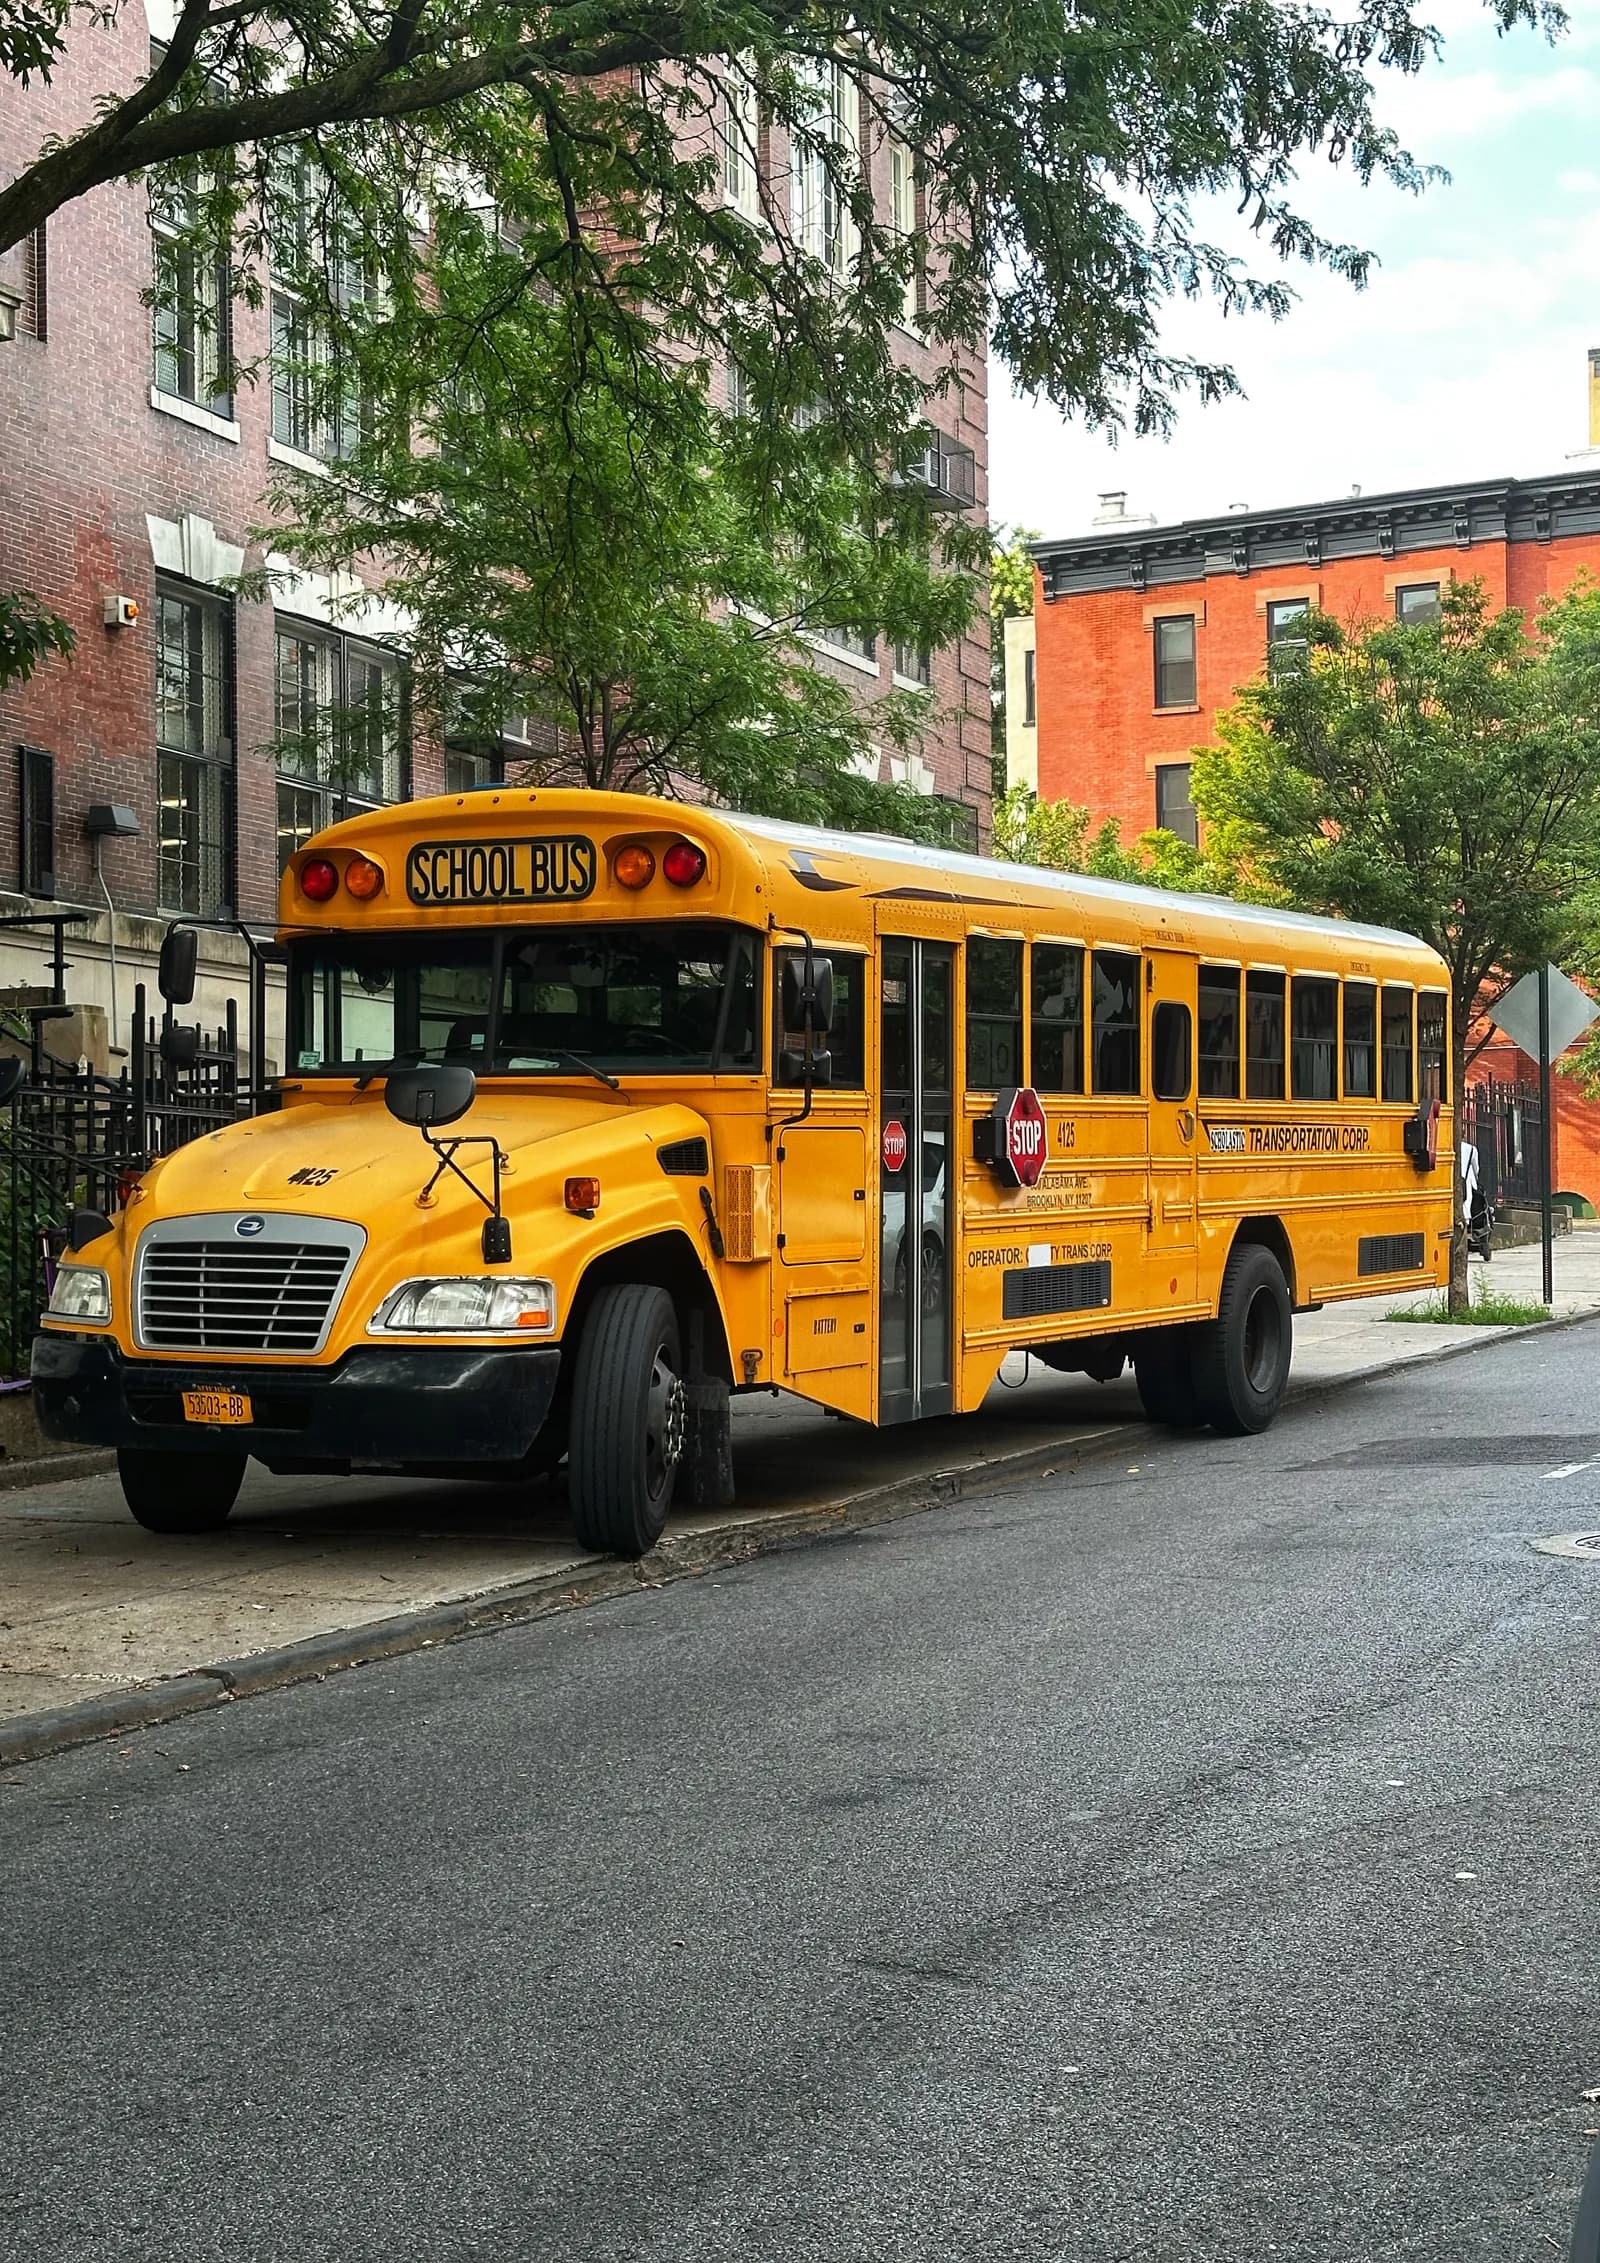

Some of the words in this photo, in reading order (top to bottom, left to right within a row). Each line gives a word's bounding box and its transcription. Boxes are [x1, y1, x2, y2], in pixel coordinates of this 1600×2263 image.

[413, 847, 525, 900] SCHOOL
[531, 841, 589, 894] BUS
[884, 1138, 904, 1155] STOP
[1013, 1120, 1042, 1155] STOP
[1057, 1121, 1075, 1148] 4125
[1250, 1128, 1338, 1151] TRANSPORTATION
[1342, 1127, 1370, 1150] CORP.
[1064, 1193, 1075, 1206] NY
[968, 1247, 1023, 1267] OPERATOR:
[1062, 1244, 1089, 1260] TRANS
[1090, 1243, 1113, 1257] CORP.
